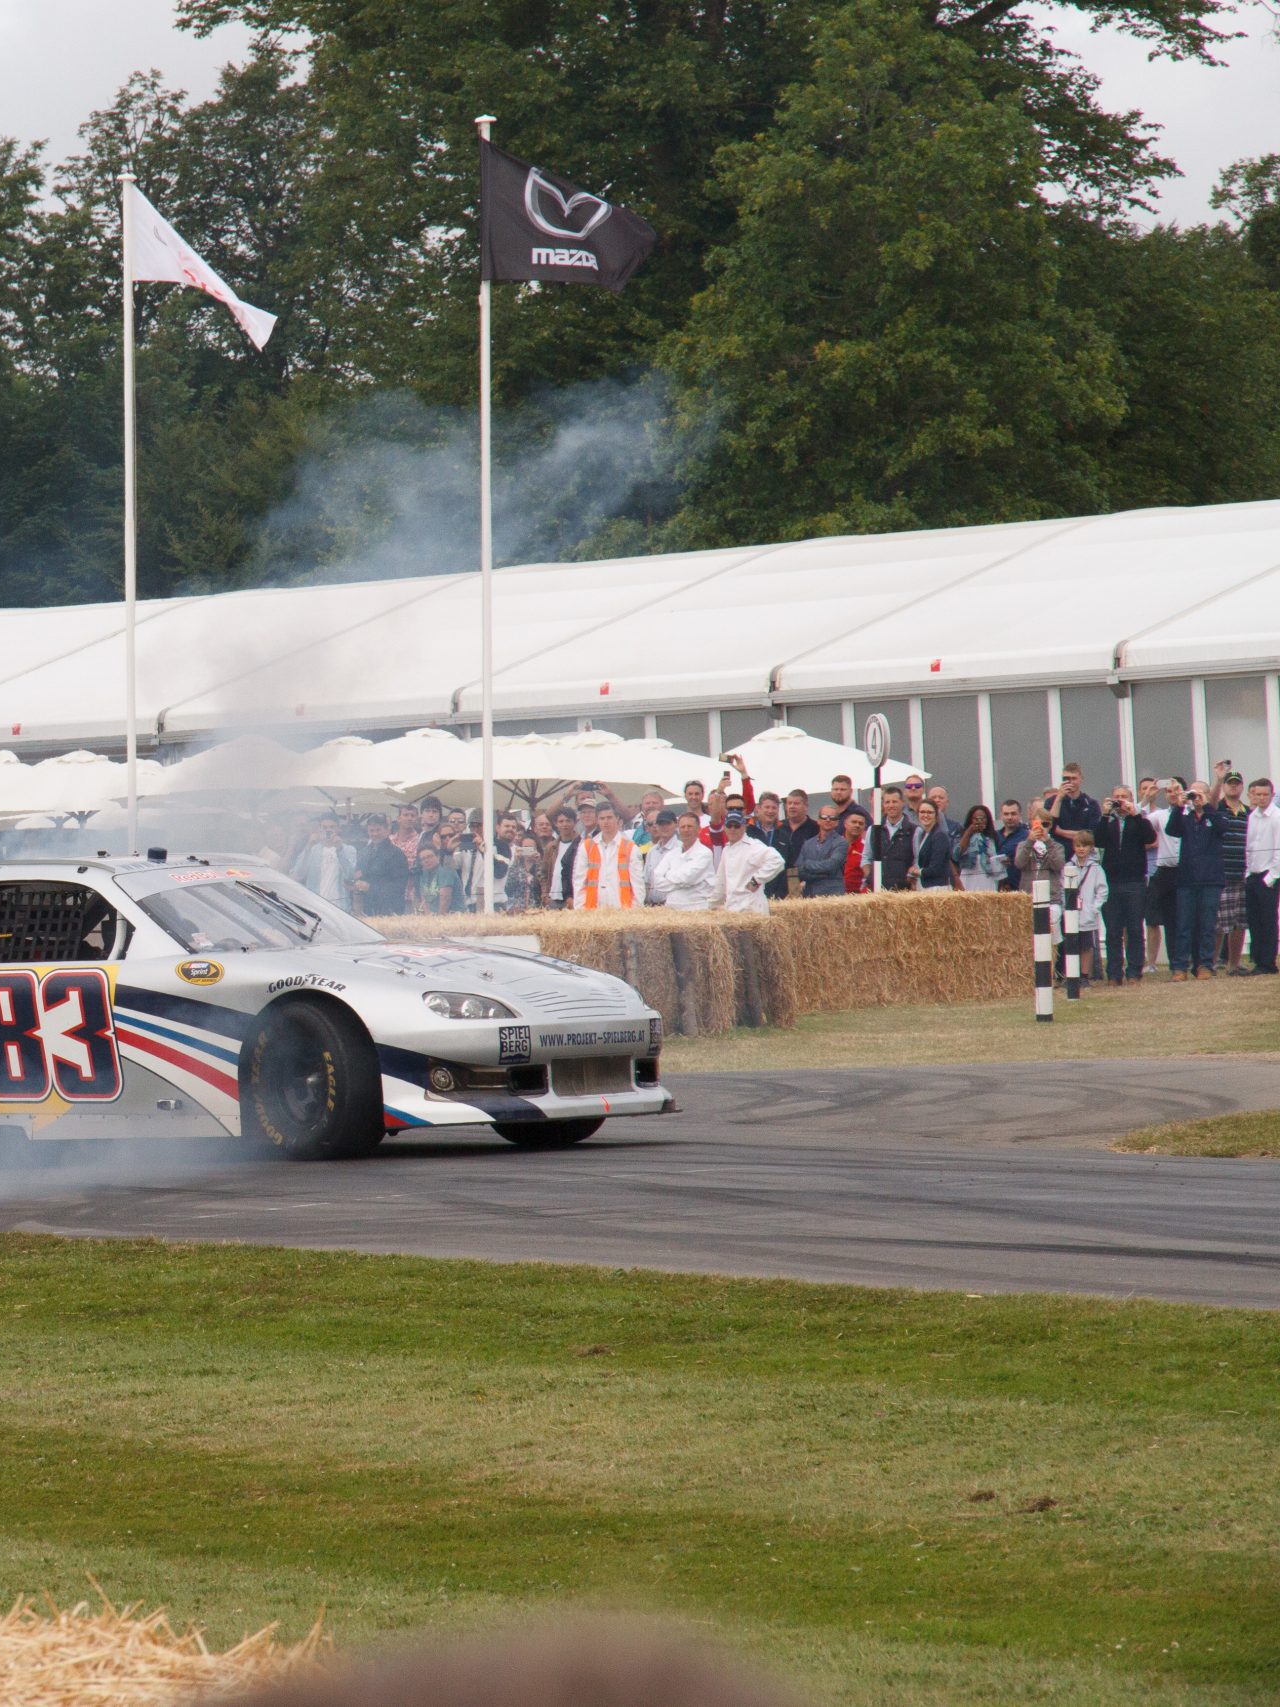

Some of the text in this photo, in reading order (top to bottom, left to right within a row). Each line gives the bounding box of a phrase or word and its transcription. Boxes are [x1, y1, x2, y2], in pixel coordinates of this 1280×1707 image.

[190, 968, 209, 976] Sprint
[500, 1027, 529, 1040] SPIEL
[501, 1039, 528, 1053] BERG
